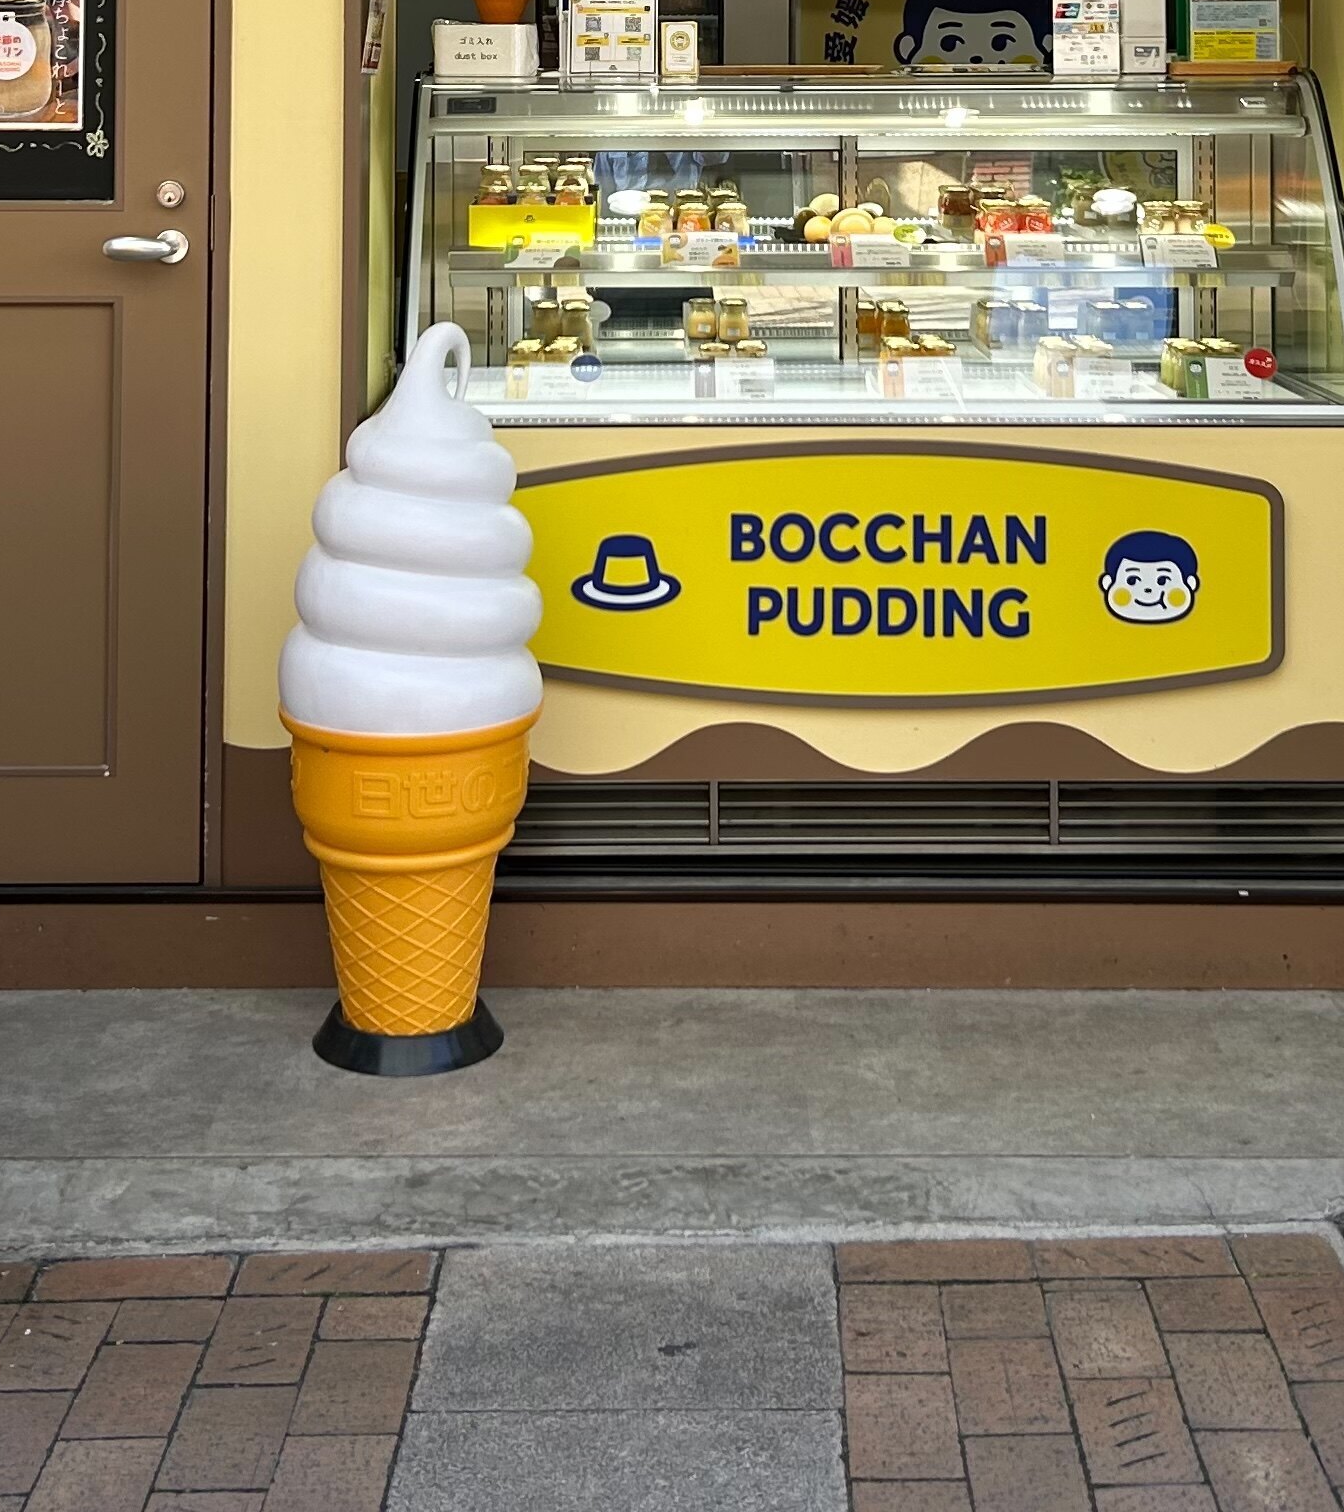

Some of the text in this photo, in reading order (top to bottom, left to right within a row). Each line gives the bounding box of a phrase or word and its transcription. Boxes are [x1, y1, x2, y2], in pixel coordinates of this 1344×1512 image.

[454, 52, 498, 61] dust box
[459, 37, 494, 46] ゴミ入れ
[730, 513, 1047, 565] BOCCHAN
[747, 587, 1030, 639] PUDDING
